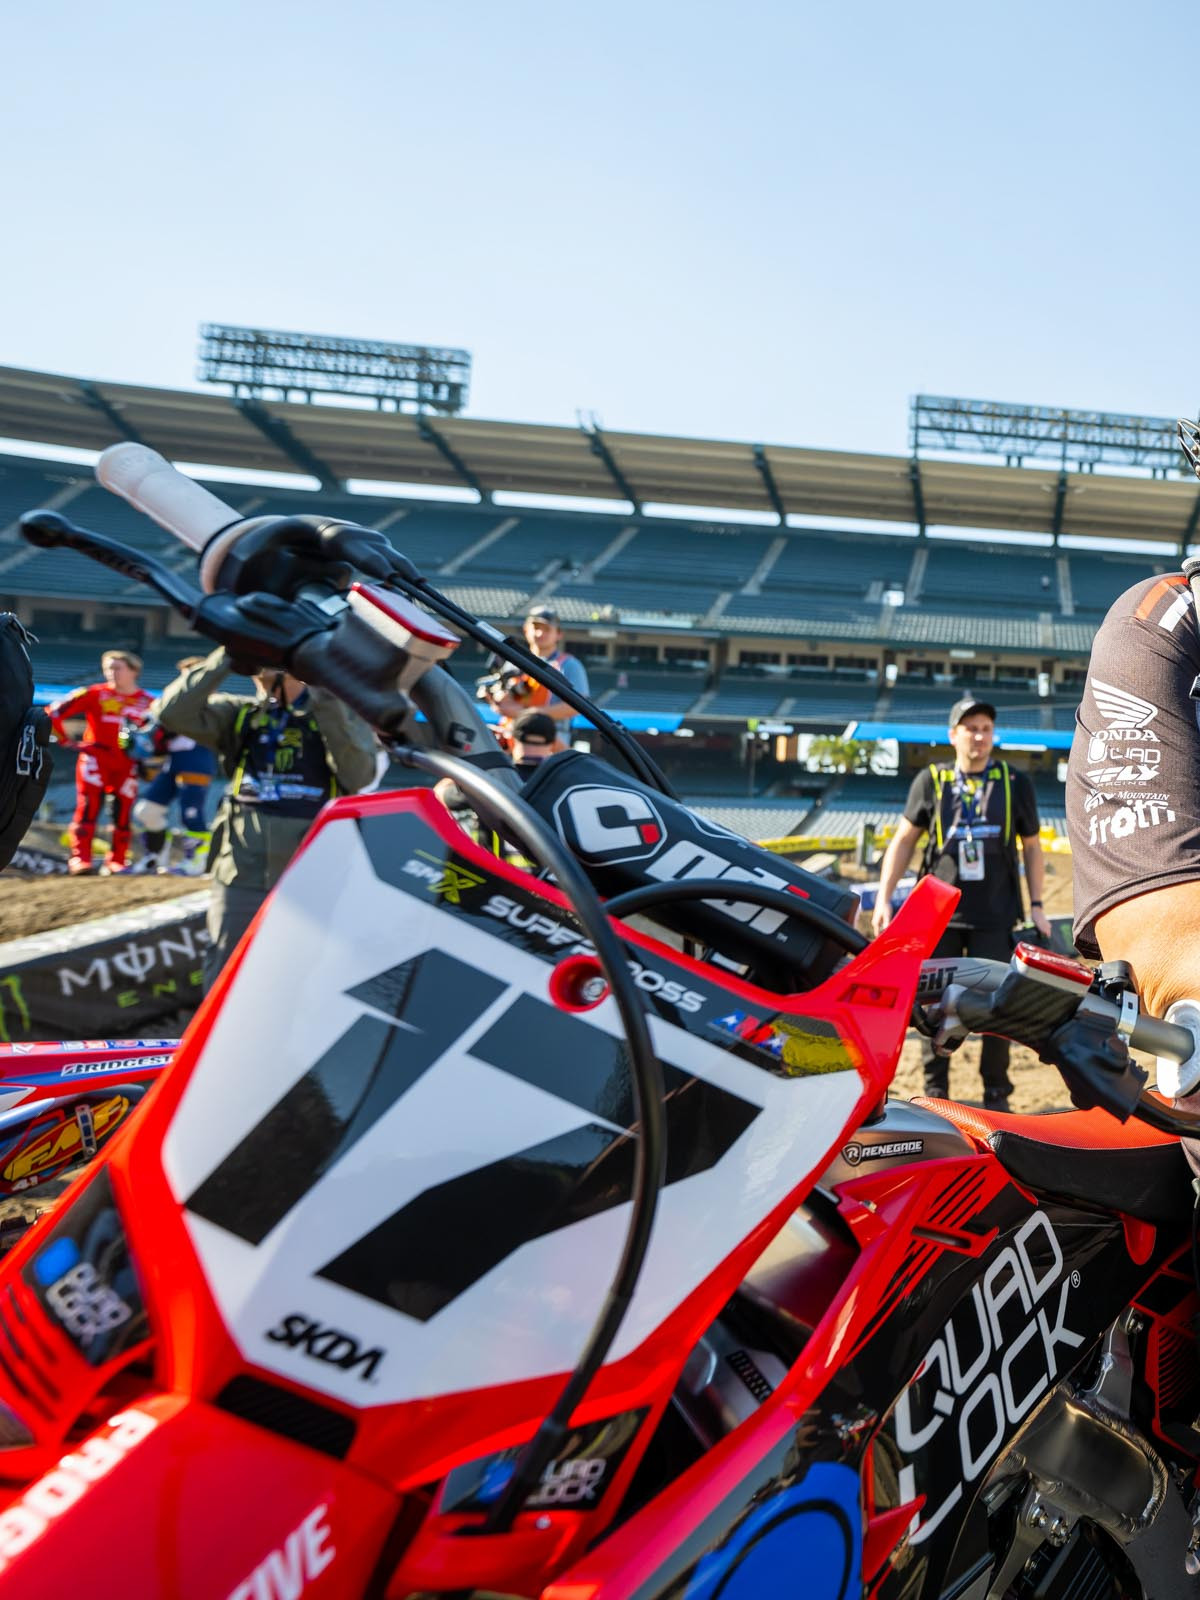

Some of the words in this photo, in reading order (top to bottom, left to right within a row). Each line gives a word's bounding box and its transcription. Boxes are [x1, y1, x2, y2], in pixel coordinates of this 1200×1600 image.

[1093, 729, 1161, 742] ONDA
[481, 894, 707, 1013] SUPEROSS
[62, 1055, 175, 1077] BRIDGEST
[184, 946, 764, 1324] 17
[861, 1140, 923, 1157] RENEGADE
[264, 1311, 386, 1381] SKDA
[894, 1210, 1064, 1453] QUAD
[898, 1275, 1086, 1545] LOCK
[0, 1408, 159, 1574] PROG
